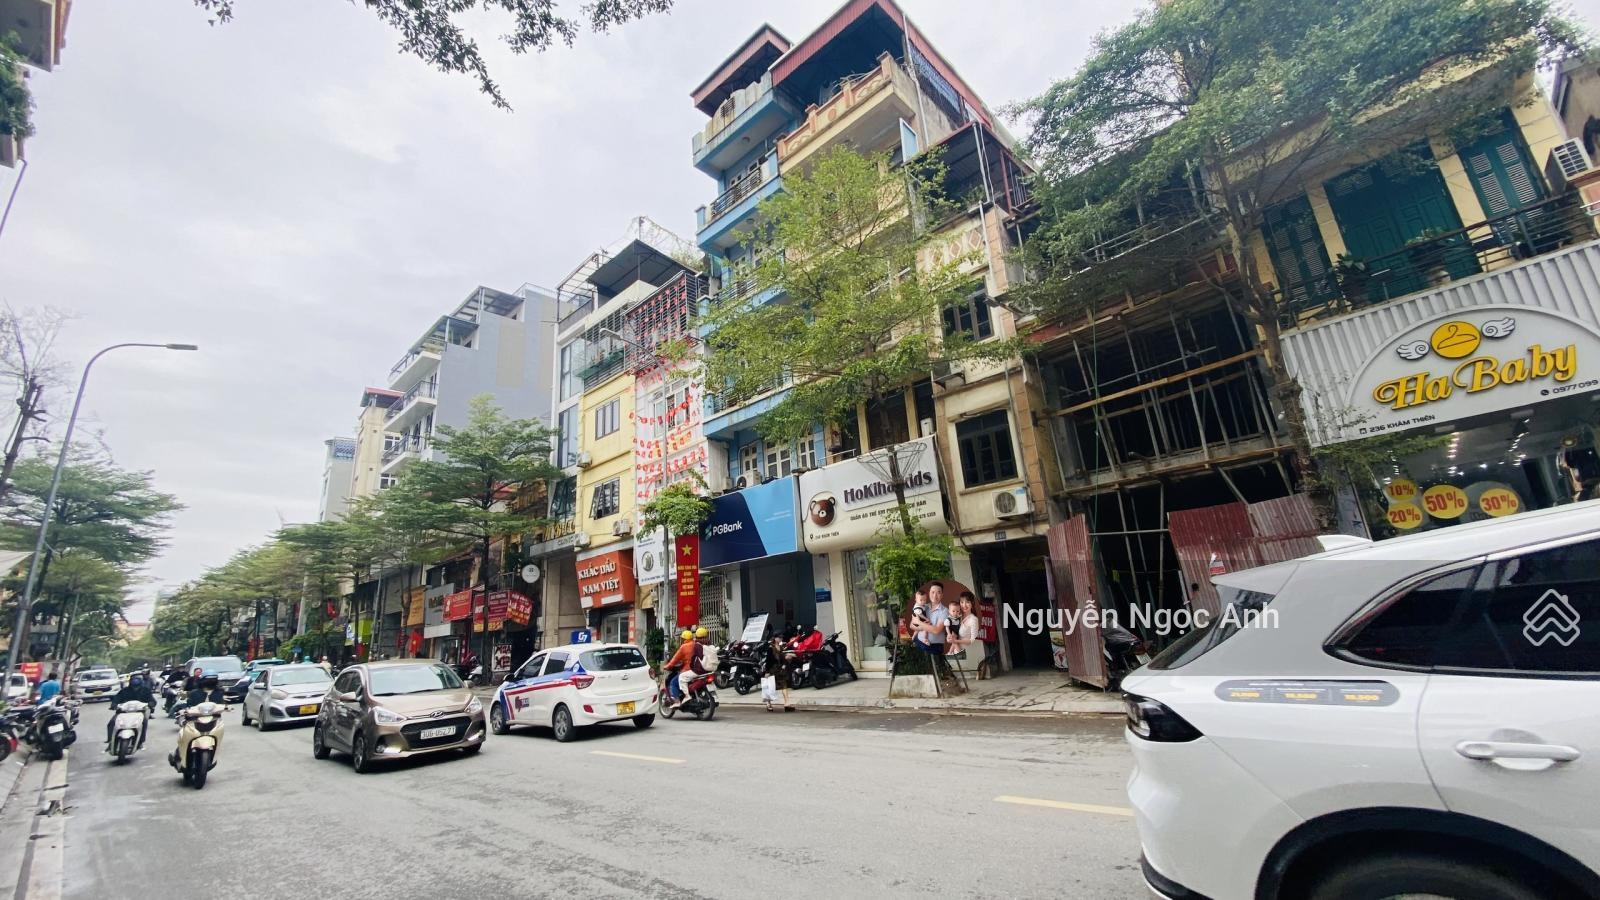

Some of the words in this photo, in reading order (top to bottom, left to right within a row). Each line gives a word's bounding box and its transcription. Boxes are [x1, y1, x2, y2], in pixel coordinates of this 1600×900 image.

[1372, 371, 1452, 410] Ha
[1452, 344, 1578, 394] Baby
[1552, 384, 1577, 394] 0977
[1578, 379, 1599, 388] 099
[1369, 423, 1386, 433] 236
[1387, 483, 1415, 499] 10%
[1424, 490, 1465, 513] 50%
[1481, 493, 1517, 512] 30%
[1388, 508, 1421, 524] 20%
[712, 520, 743, 537] PGBank
[582, 583, 601, 595] NAM
[601, 577, 620, 592] VIỆT
